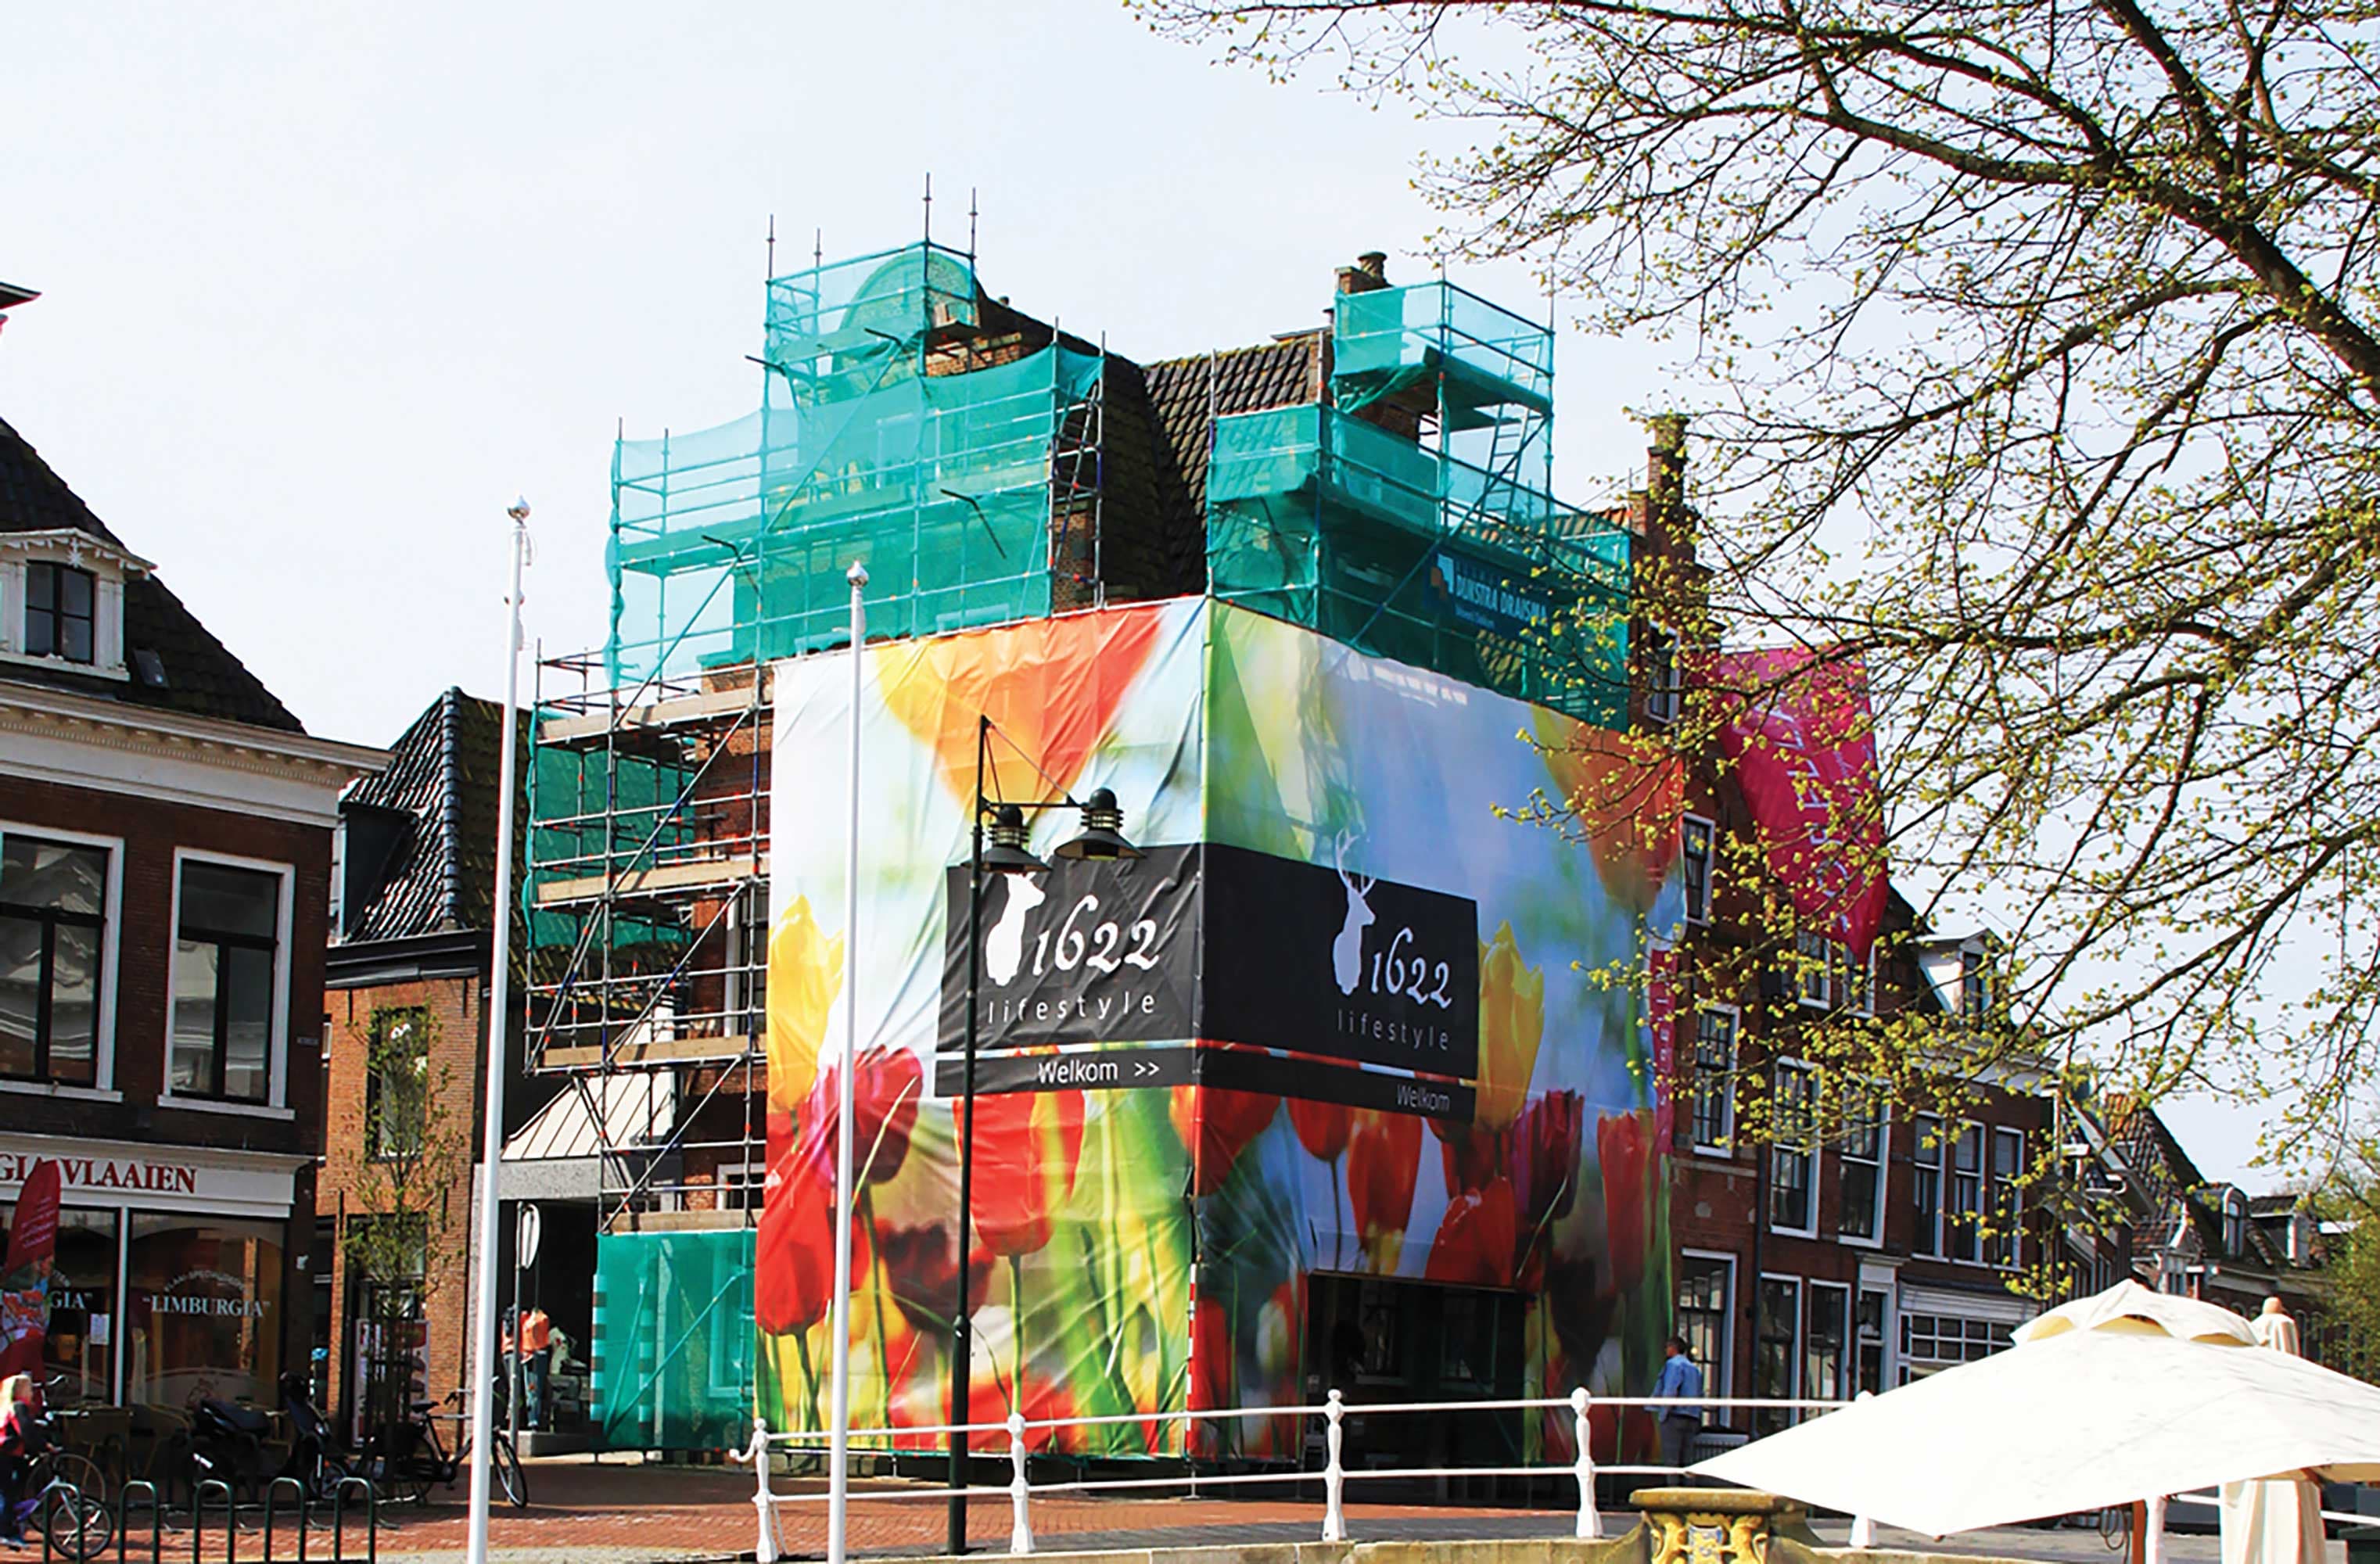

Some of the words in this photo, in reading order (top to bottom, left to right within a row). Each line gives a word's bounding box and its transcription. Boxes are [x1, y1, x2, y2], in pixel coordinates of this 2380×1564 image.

[1032, 895, 1159, 976] 1622
[1371, 927, 1452, 1009] 1622
[989, 991, 1155, 1024] lifestyle
[1337, 1009, 1448, 1050] lifestyle
[1038, 1059, 1118, 1084] Welkom
[1397, 1083, 1450, 1112] Welkom
[60, 1157, 198, 1193] VLAAIEN
